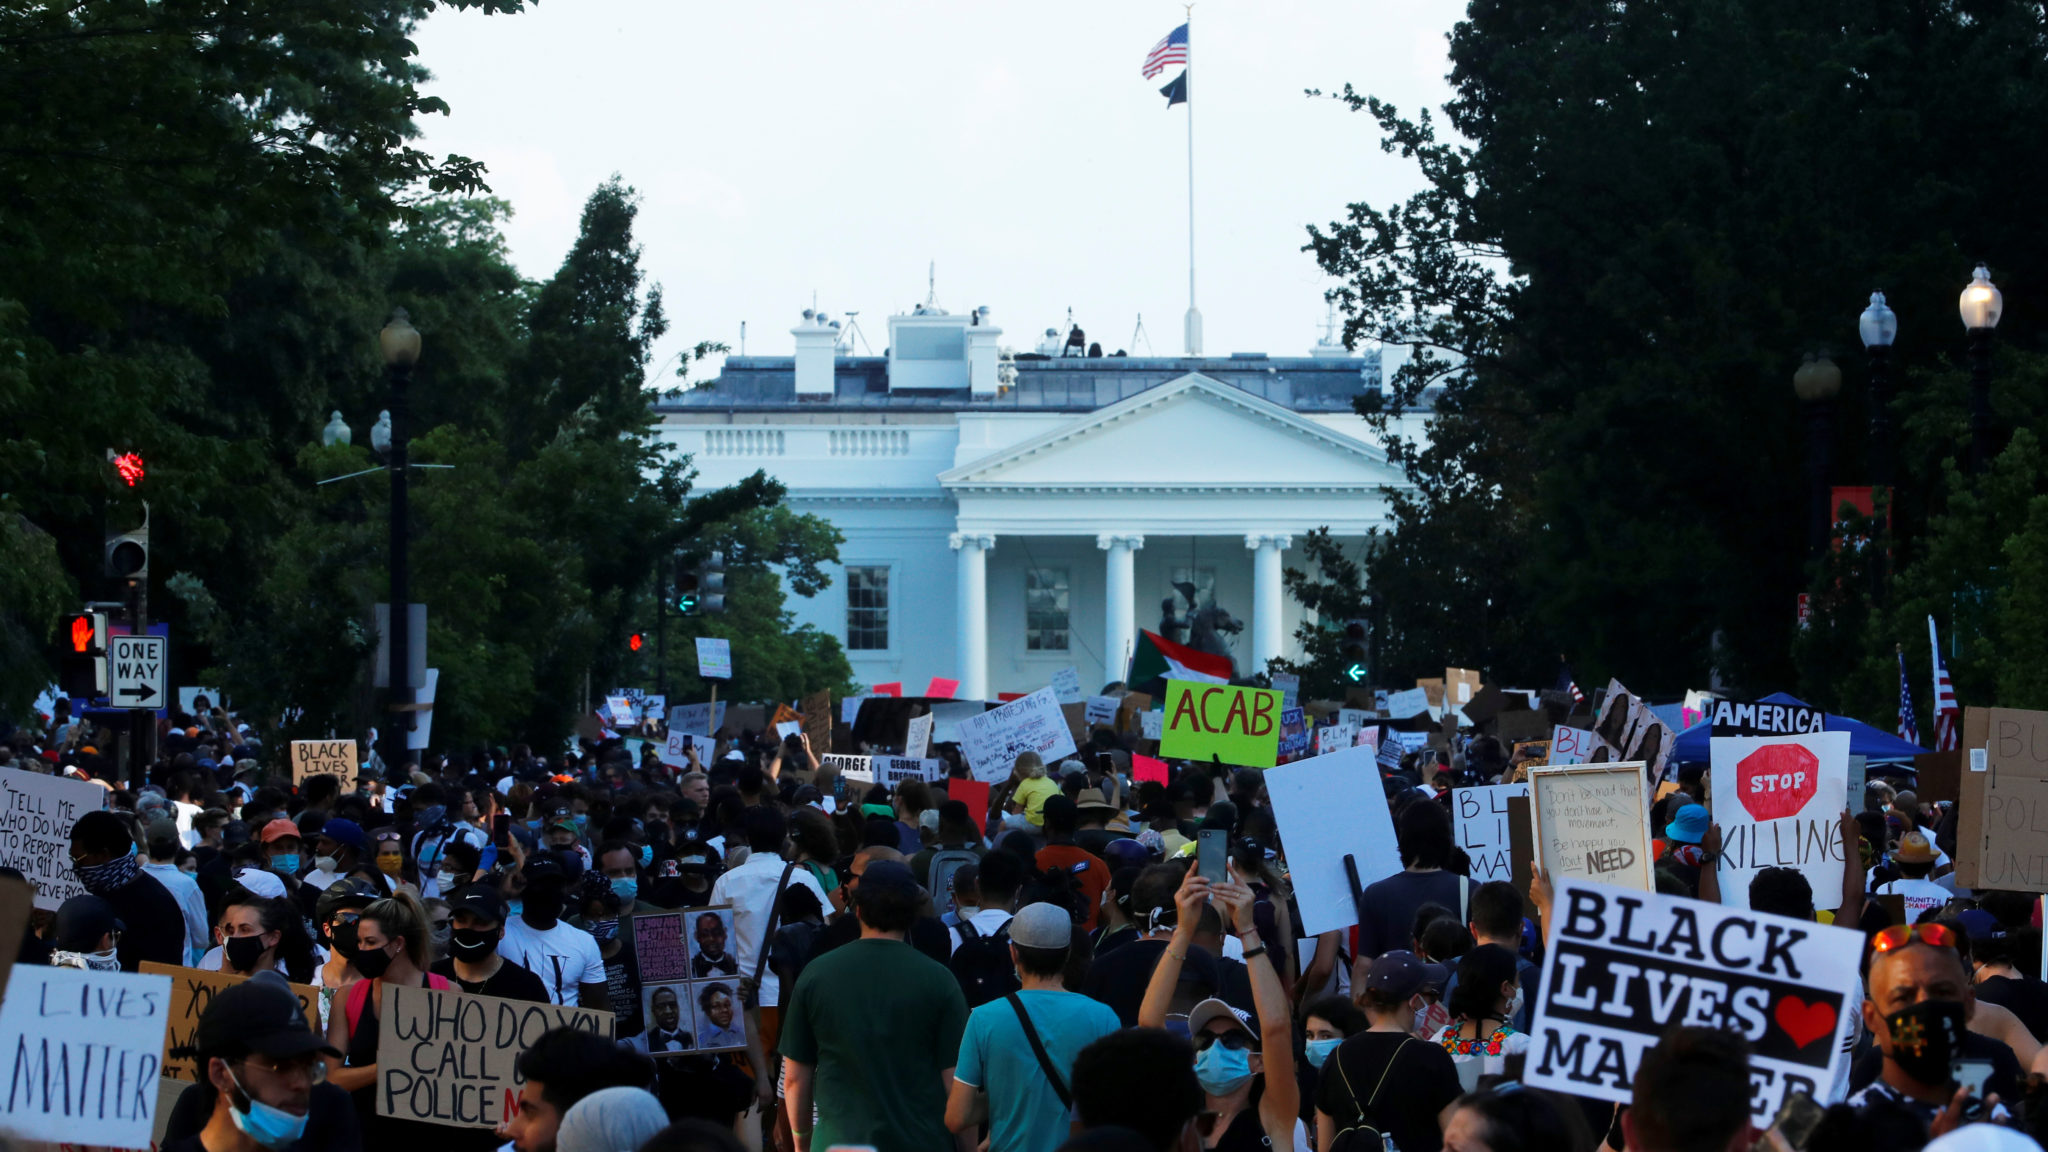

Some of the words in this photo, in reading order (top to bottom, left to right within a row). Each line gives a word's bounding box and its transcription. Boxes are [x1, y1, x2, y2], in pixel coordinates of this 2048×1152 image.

[118, 643, 158, 660] ONE
[118, 663, 159, 679] WAY
[1170, 687, 1274, 736] ACAB
[1282, 711, 1300, 725] UCK
[1712, 700, 1824, 734] AMERICA
[668, 736, 704, 761] BM
[1322, 726, 1348, 741] BLM
[1556, 727, 1584, 756] BL
[298, 742, 349, 762] BLACK
[304, 760, 348, 773] LIVES
[890, 759, 921, 770] GEORGE
[1750, 771, 1806, 793] STOP
[32, 815, 50, 835] DO
[1463, 818, 1503, 849] LI
[0, 829, 19, 849] TO
[22, 833, 65, 859] REPORT
[1716, 819, 1846, 872] KILLING
[0, 849, 34, 874] WHEN
[37, 855, 52, 878] 911
[56, 861, 81, 883] DOIN
[1469, 849, 1512, 879] MA
[1586, 847, 1635, 875] NEED
[1561, 887, 1808, 979] BLACK
[40, 981, 160, 1019] LIVES
[1551, 953, 1770, 1042] LIVES
[394, 987, 487, 1042] WHO
[495, 1001, 549, 1050] DO
[410, 1040, 500, 1081] CALL
[1536, 1027, 1817, 1121] MAER
[7, 1032, 157, 1122] MATTER
[385, 1068, 498, 1125] POLICE
